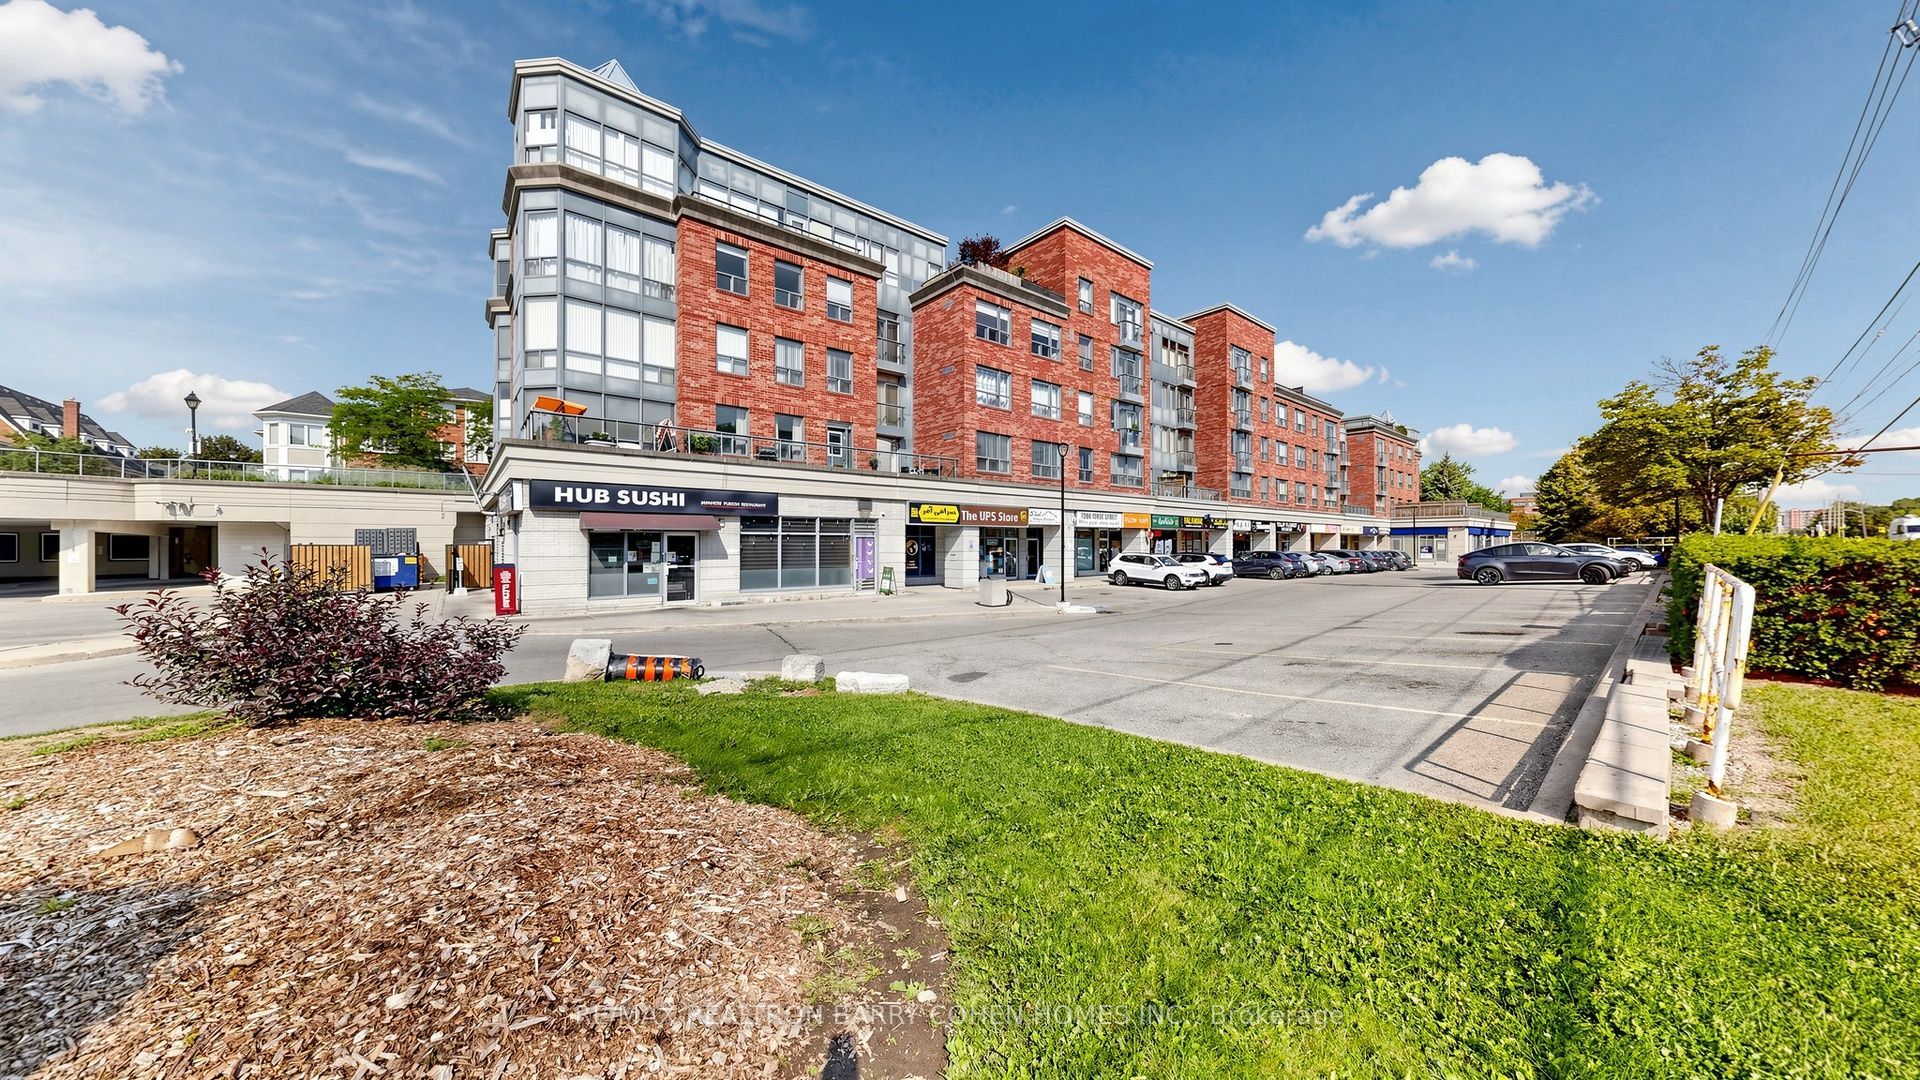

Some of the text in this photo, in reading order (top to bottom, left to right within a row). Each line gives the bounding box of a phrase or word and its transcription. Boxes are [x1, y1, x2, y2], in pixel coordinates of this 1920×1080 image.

[554, 486, 686, 507] HUB SUSHI
[961, 510, 977, 520] The
[980, 511, 996, 521] UPS
[998, 511, 1019, 522] Store
